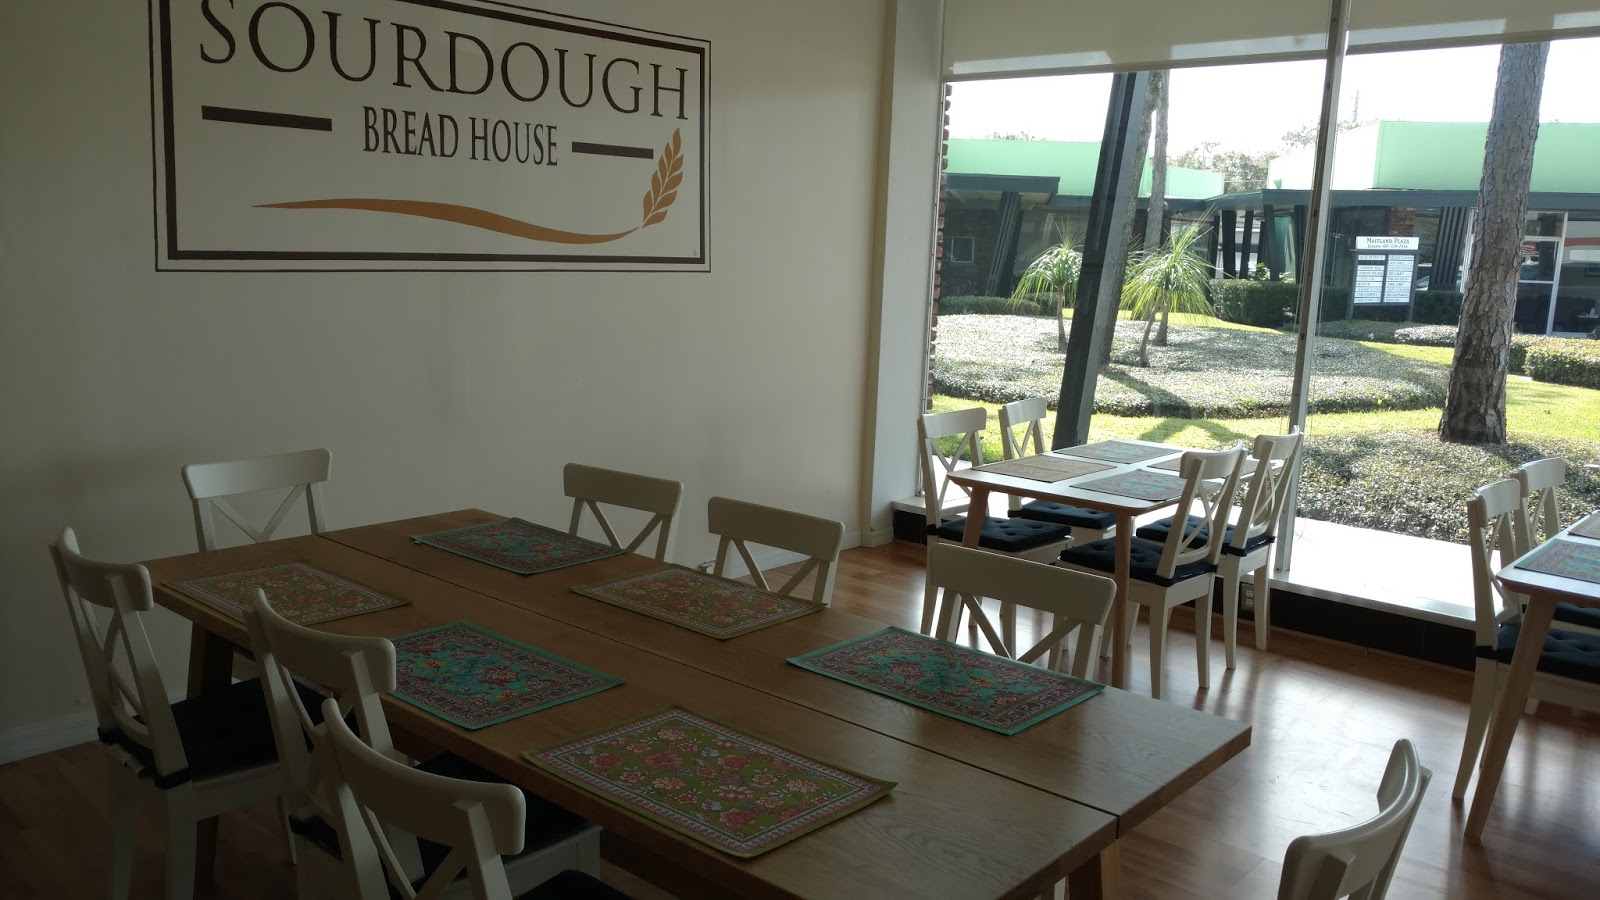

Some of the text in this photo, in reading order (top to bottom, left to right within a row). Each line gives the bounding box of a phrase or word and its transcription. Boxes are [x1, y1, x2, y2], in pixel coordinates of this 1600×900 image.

[200, 0, 689, 121] SOURDOUGH
[363, 105, 558, 167] BREAD HOUSE
